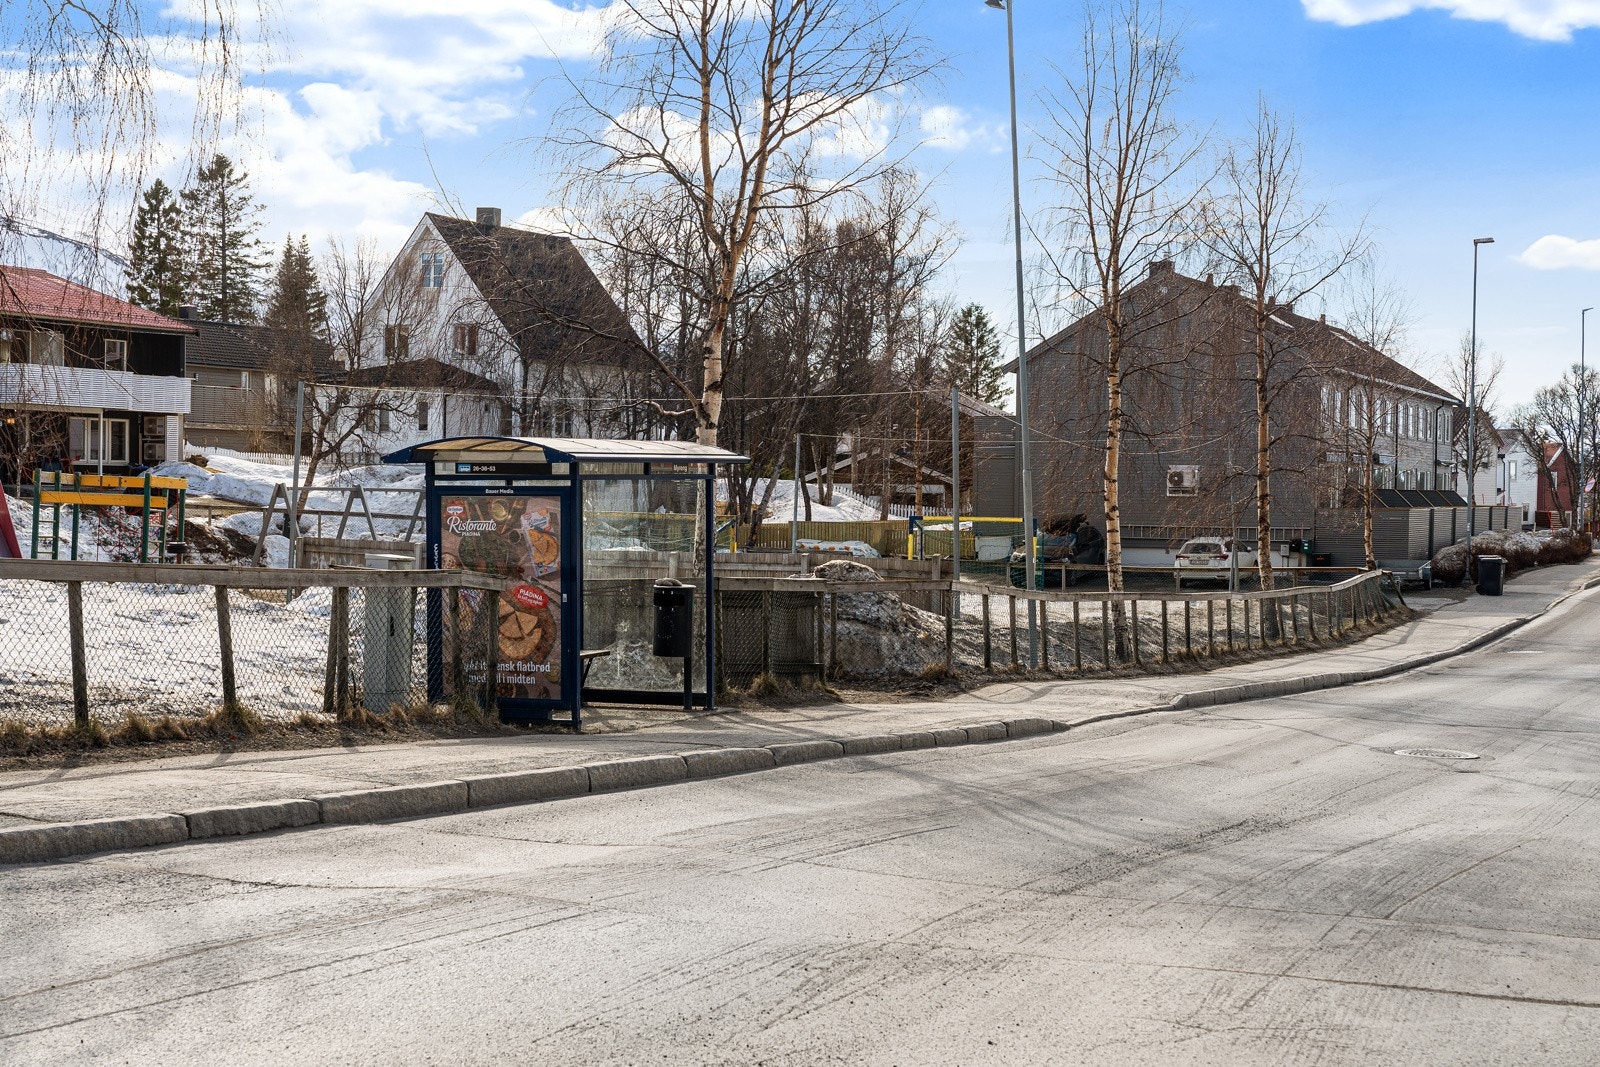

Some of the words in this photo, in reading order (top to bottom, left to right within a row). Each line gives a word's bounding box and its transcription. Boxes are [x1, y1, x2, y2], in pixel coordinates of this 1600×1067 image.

[447, 516, 497, 533] Ristorante
[519, 588, 543, 601] PIADINA
[517, 660, 551, 672] flatbrød
[506, 673, 536, 684] midten
